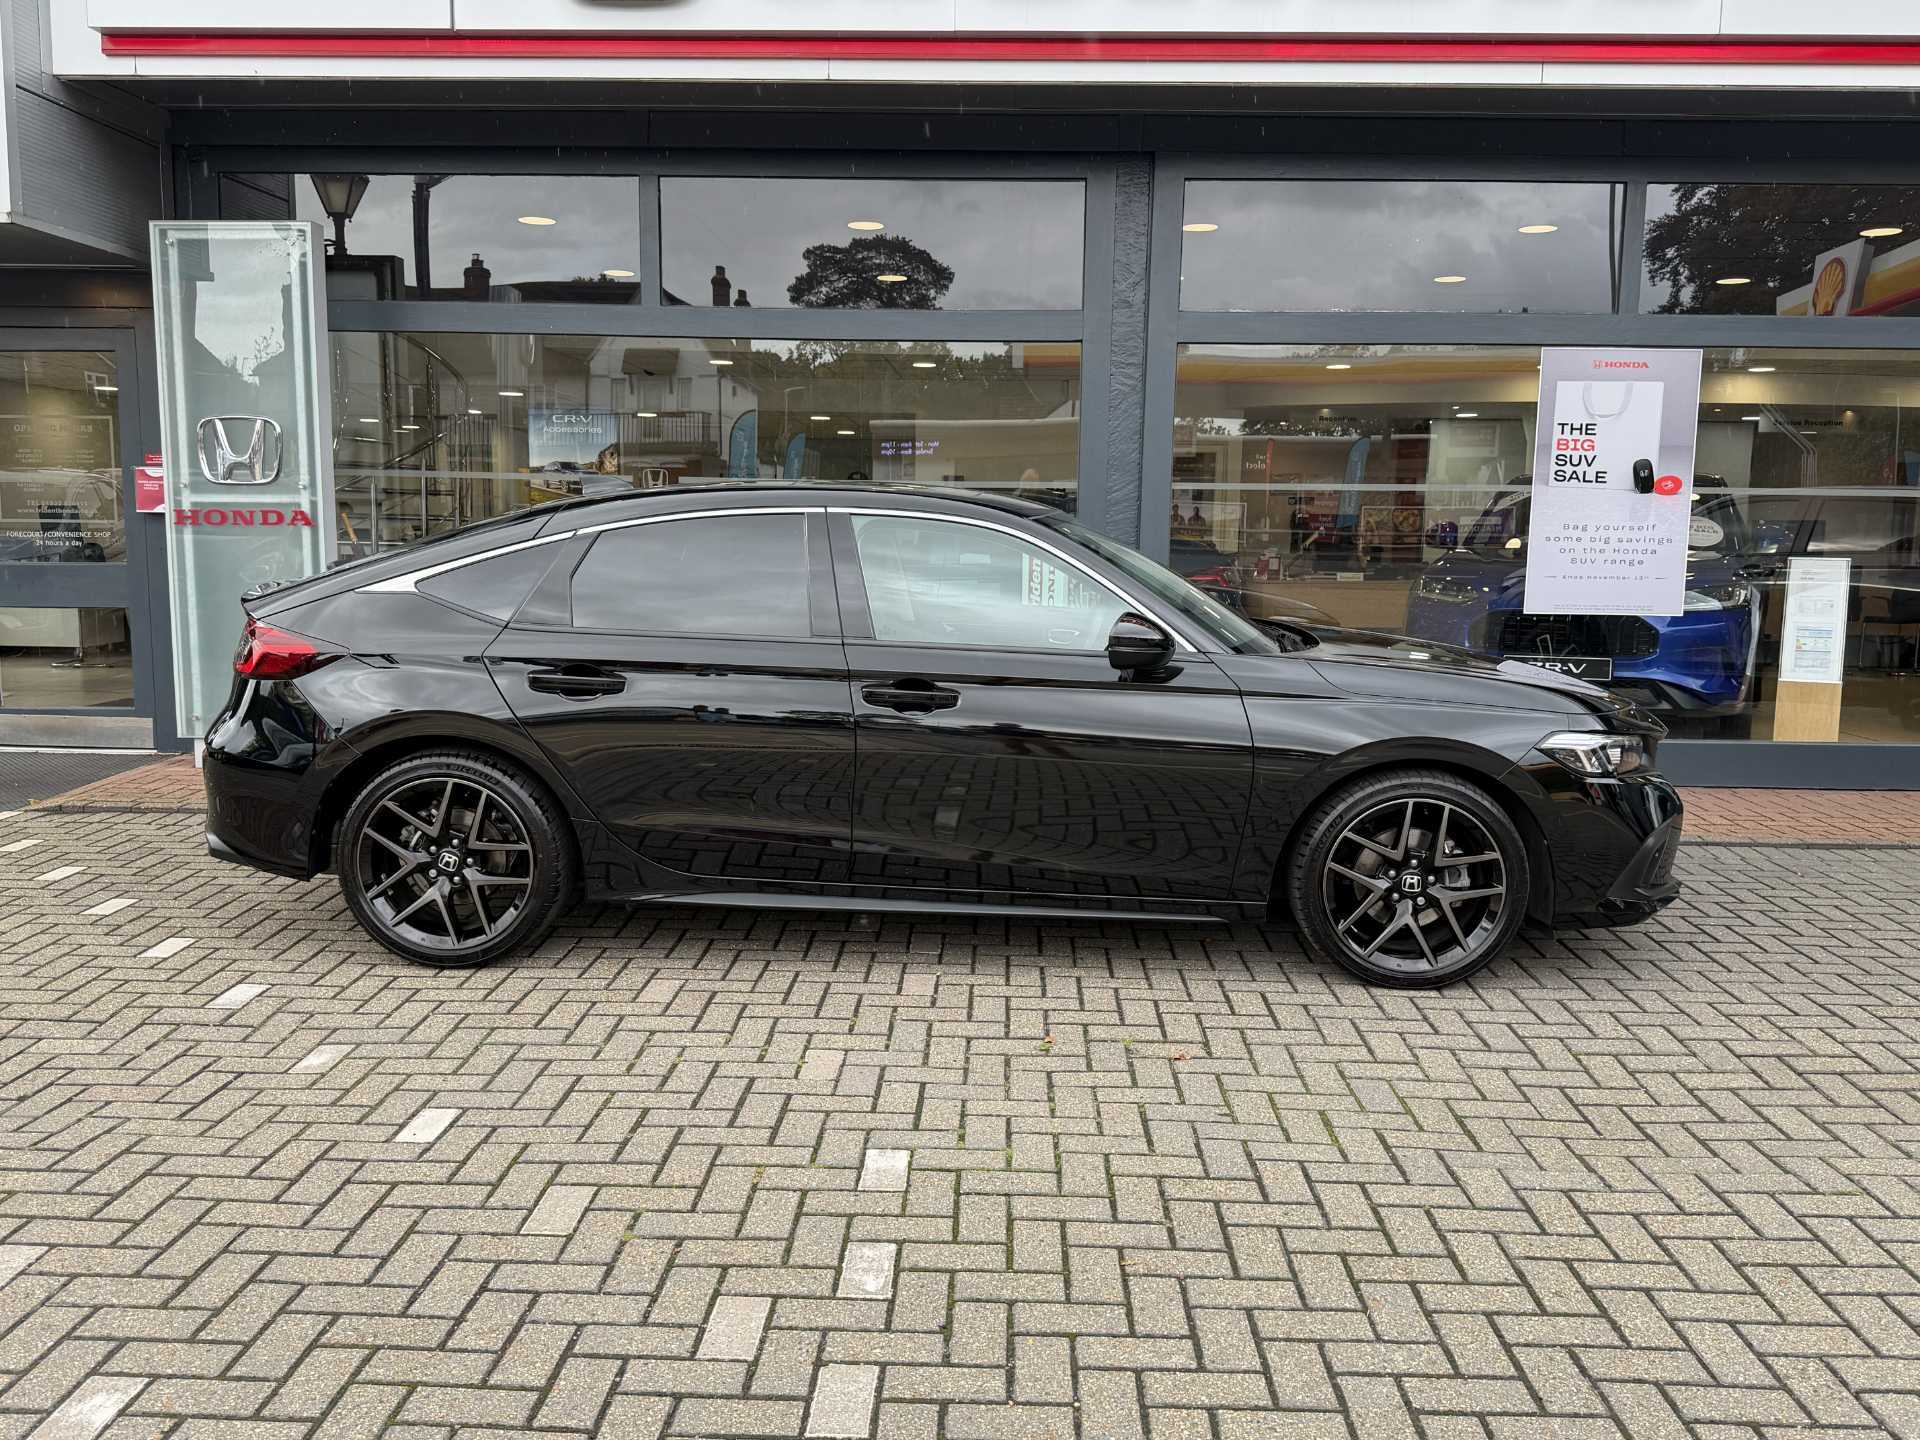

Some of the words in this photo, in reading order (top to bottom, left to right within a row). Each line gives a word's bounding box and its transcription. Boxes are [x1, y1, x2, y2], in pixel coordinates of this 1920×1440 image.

[1604, 361, 1650, 369] HONDA
[552, 414, 593, 423] CR-V
[1557, 423, 1597, 436] THE
[1556, 438, 1596, 452] BIG
[1554, 454, 1598, 468] SUV
[1553, 470, 1608, 484] SALE
[173, 508, 316, 528] HONDA
[1562, 523, 1589, 532] Bag
[1594, 523, 1657, 532] yourself
[71, 540, 83, 548] day
[1589, 535, 1611, 545] big
[1617, 535, 1673, 546] savings
[1613, 547, 1657, 555] Honda
[1569, 557, 1597, 565] SUV
[1603, 559, 1645, 567] range
